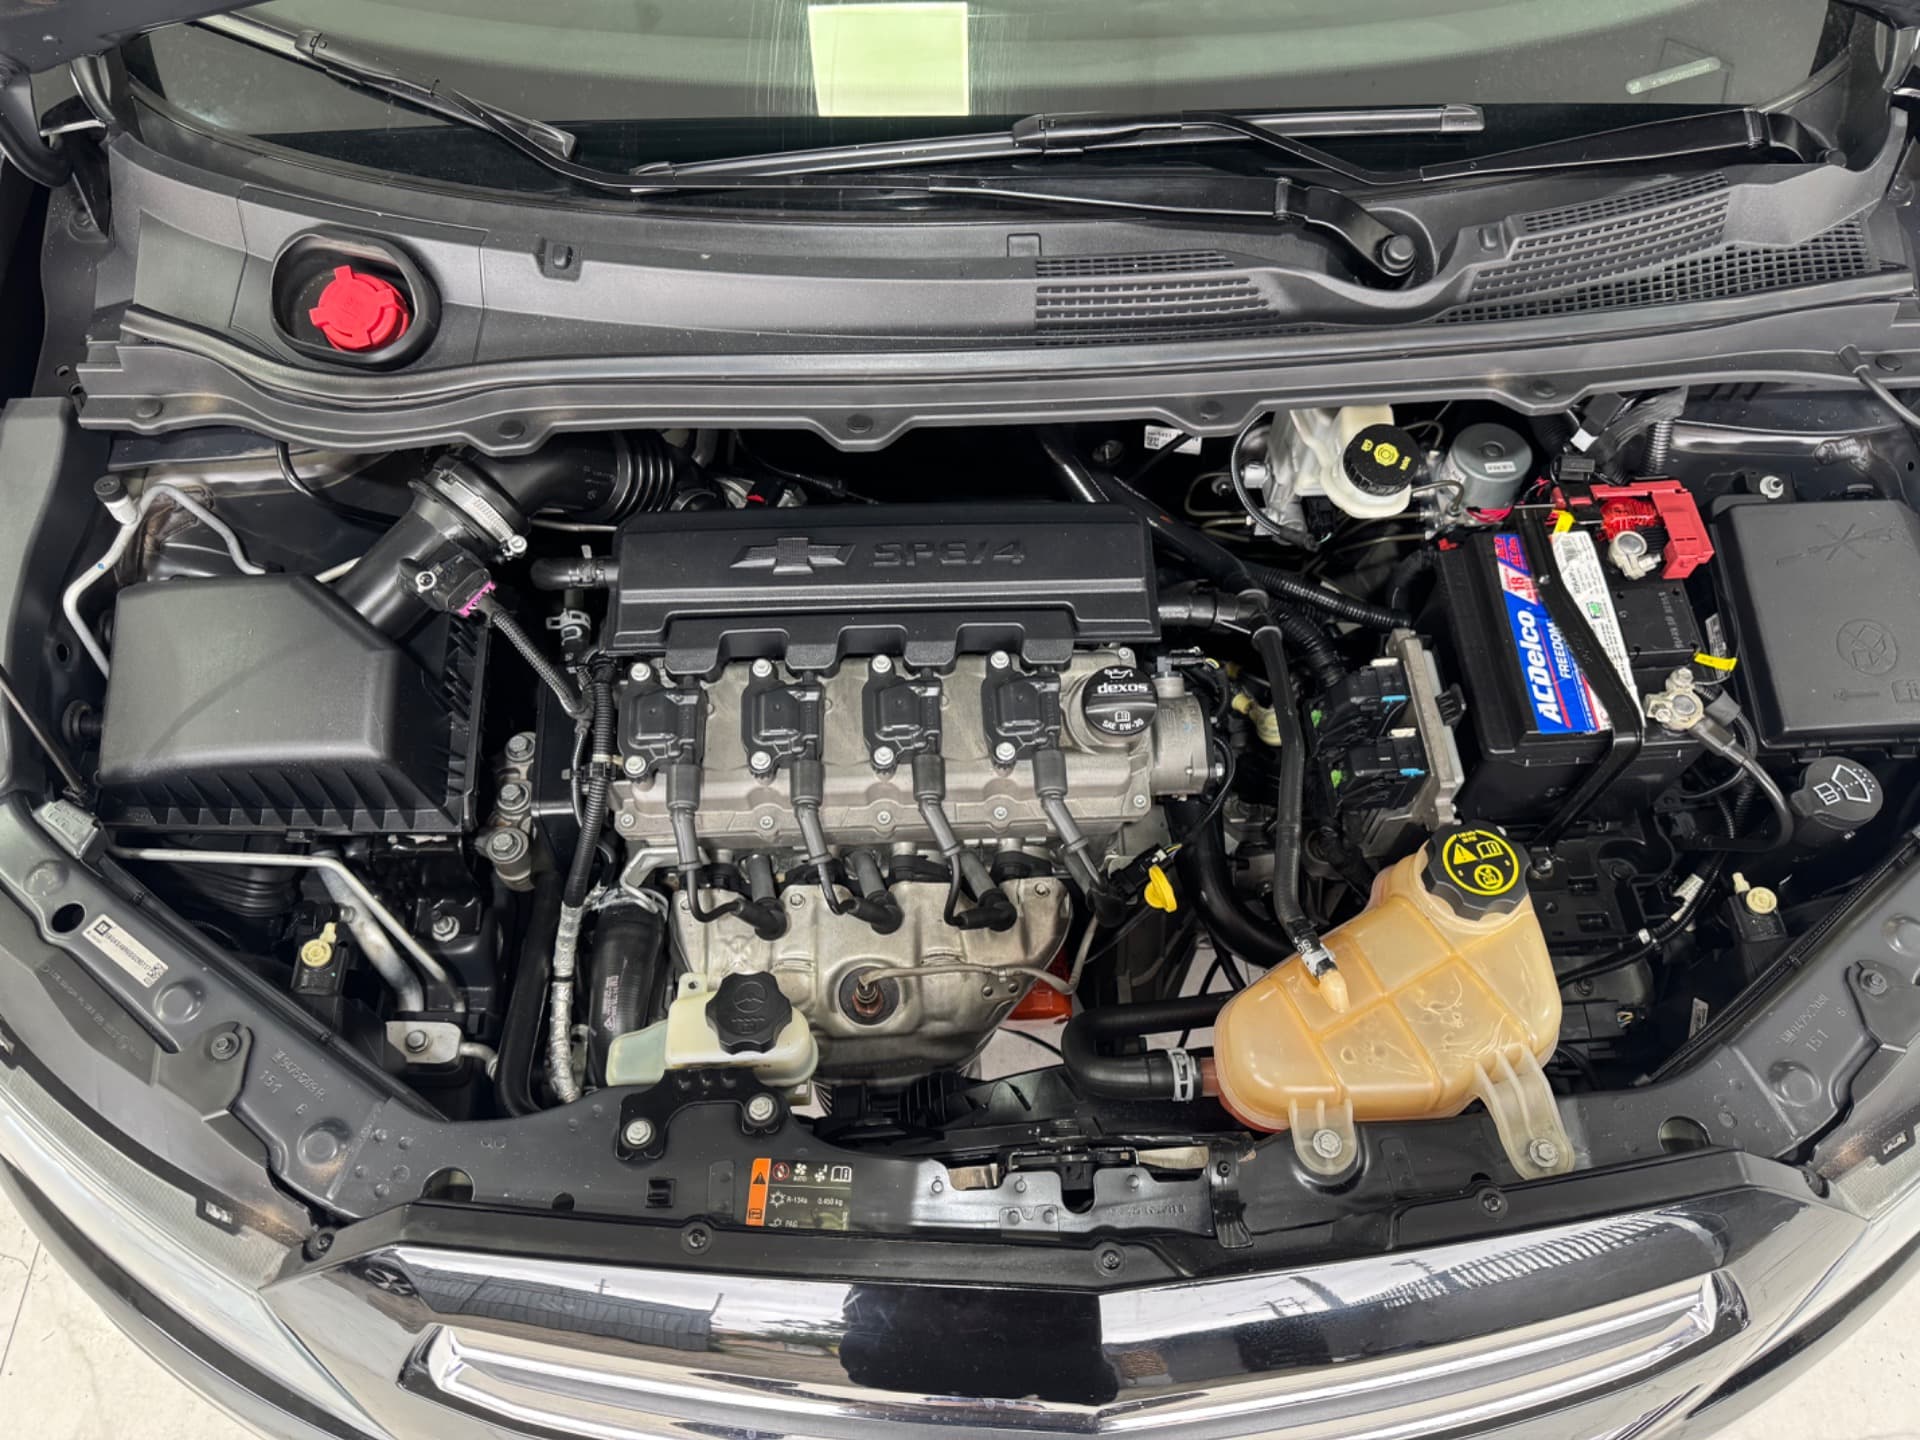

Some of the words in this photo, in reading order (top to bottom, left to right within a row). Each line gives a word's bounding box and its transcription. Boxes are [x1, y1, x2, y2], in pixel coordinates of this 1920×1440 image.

[872, 541, 1026, 567] SPE/4
[1517, 610, 1563, 725] ACDelco
[1097, 682, 1148, 694] dexos
